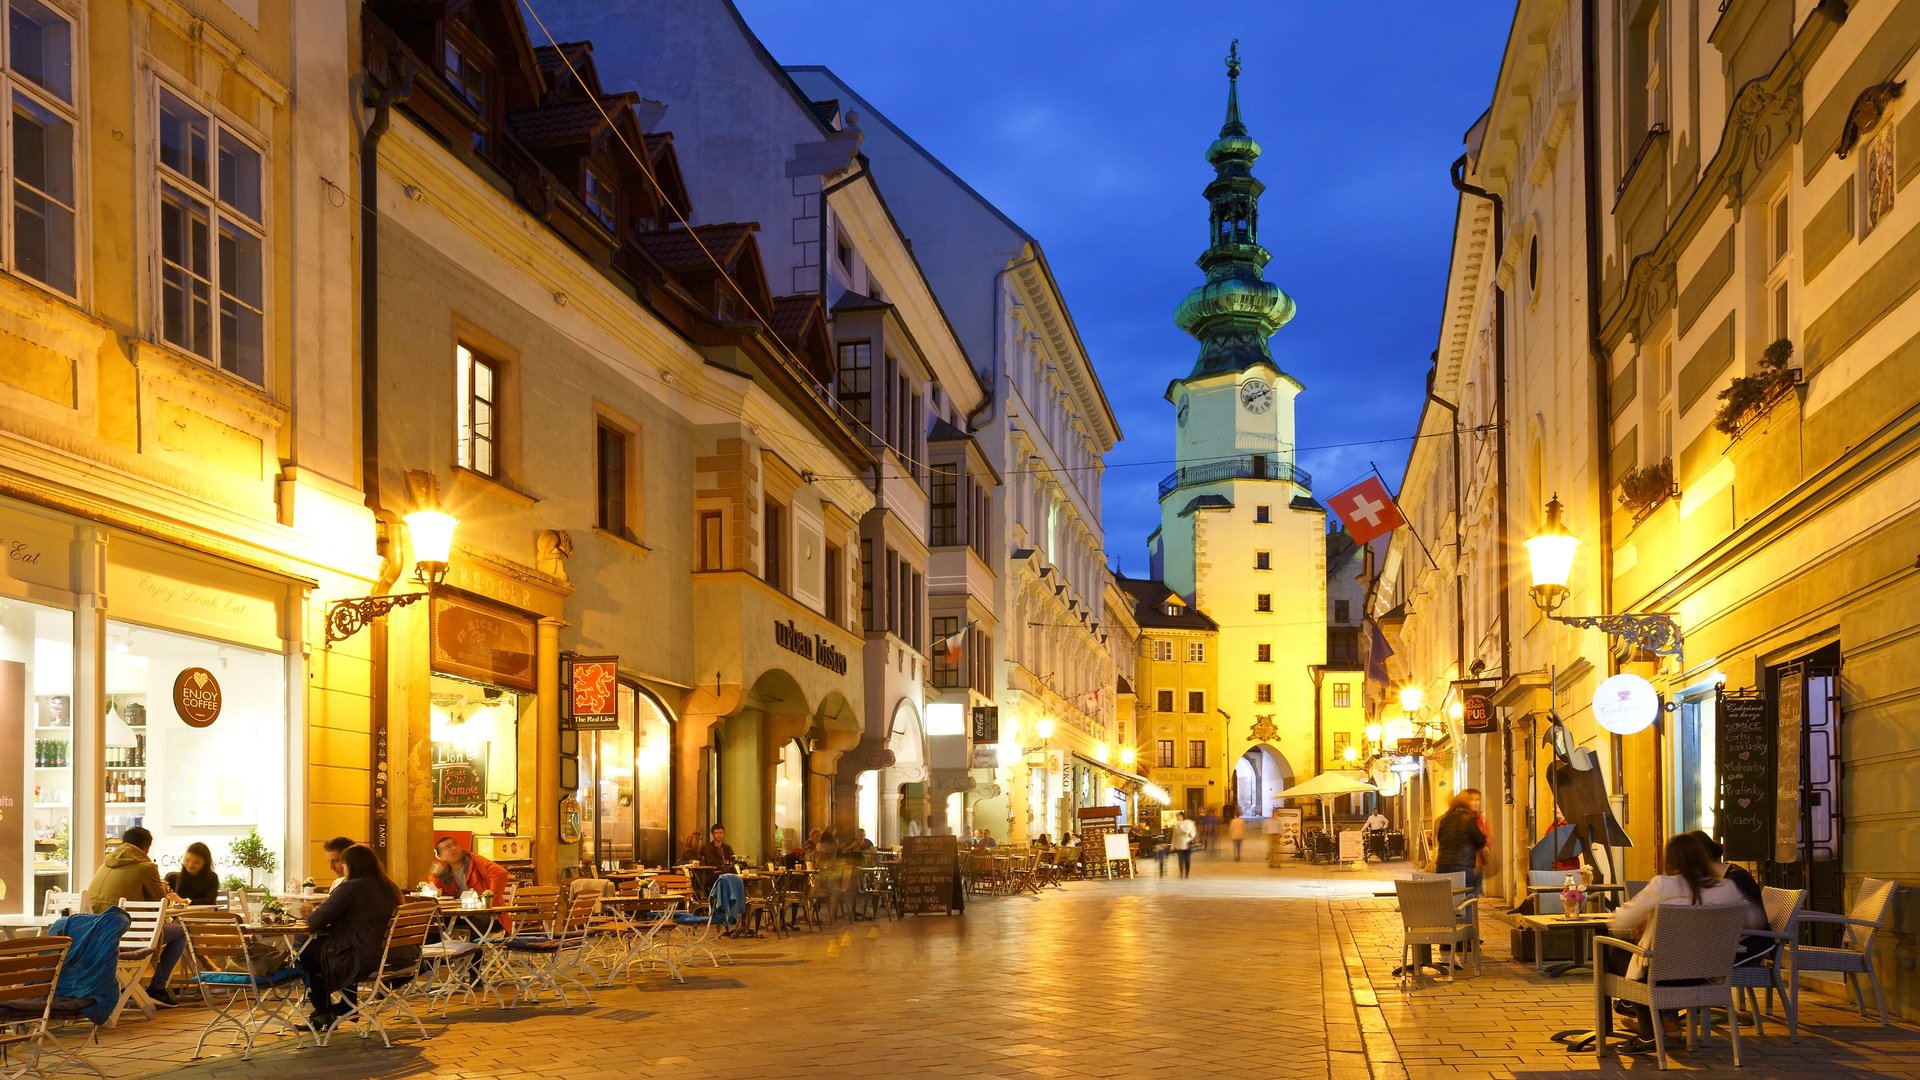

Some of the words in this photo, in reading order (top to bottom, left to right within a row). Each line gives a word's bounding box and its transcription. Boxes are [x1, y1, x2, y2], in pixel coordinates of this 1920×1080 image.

[10, 541, 41, 565] Eat
[138, 573, 175, 602] Enjoy
[774, 620, 814, 661] urban
[814, 634, 847, 676] bistro
[183, 688, 218, 701] ENJOY
[183, 698, 218, 711] COFFEE
[1466, 700, 1485, 709] Beer
[600, 714, 615, 722] Lion
[1467, 709, 1486, 720] PUB
[437, 746, 464, 764] Lion
[444, 779, 478, 796] Karaoke
[1726, 812, 1763, 833] Dezerty
